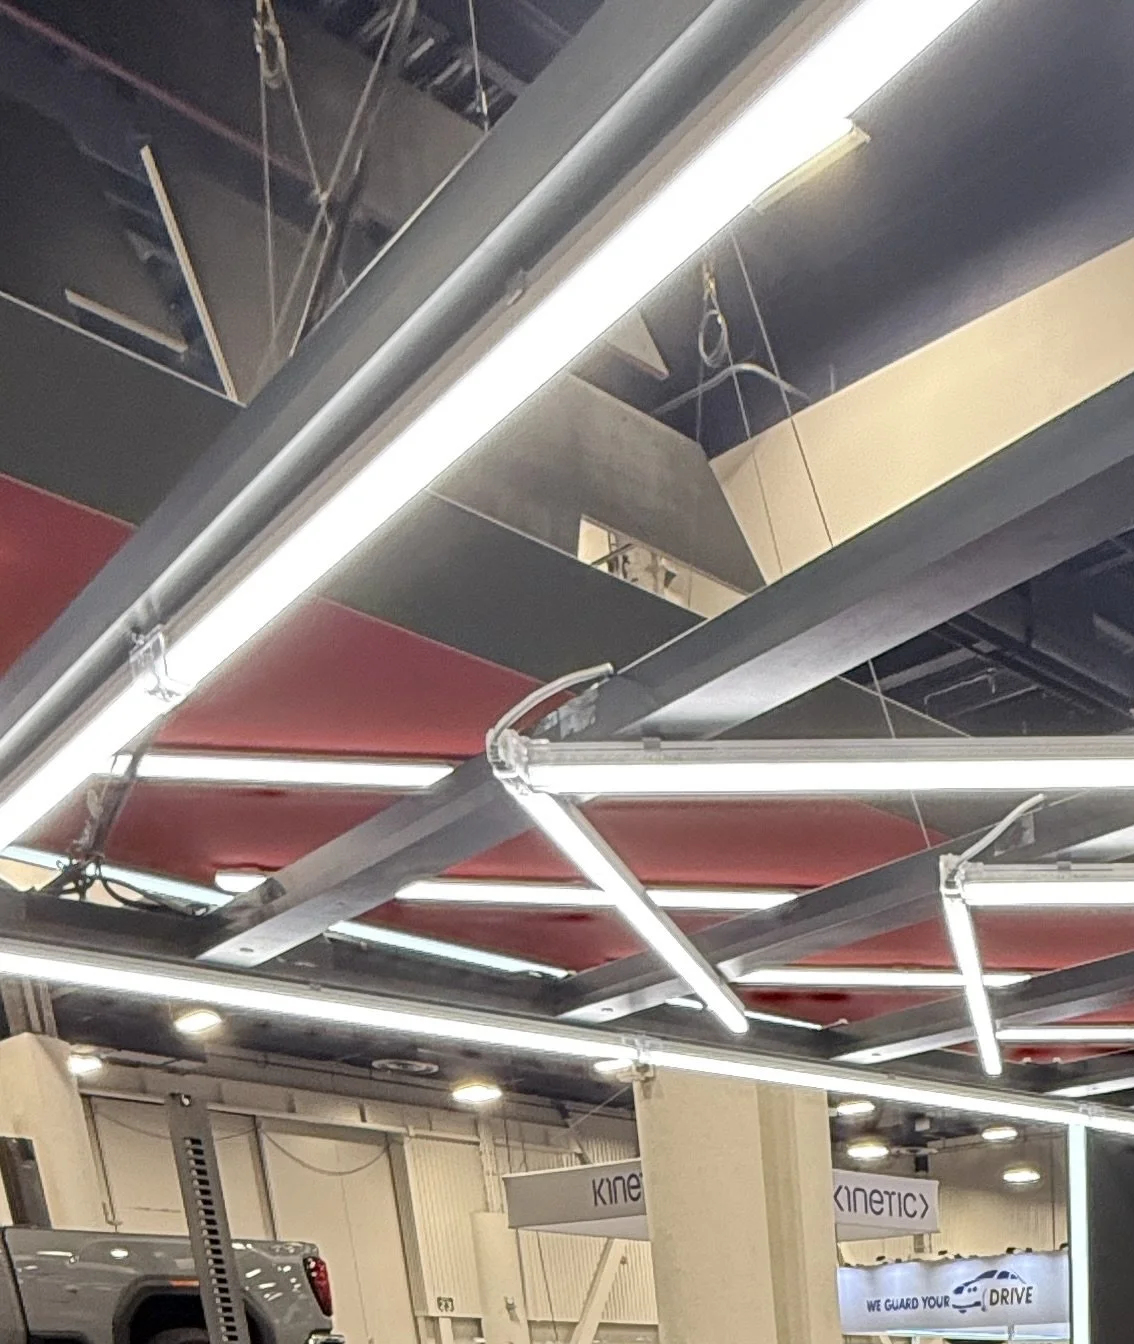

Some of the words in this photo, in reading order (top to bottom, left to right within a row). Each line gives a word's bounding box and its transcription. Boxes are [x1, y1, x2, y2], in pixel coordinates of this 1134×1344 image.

[866, 1300, 882, 1312] WE
[884, 1297, 919, 1312] GUARD
[921, 1295, 950, 1309] YOUR
[989, 1286, 1033, 1306] DRIVE
